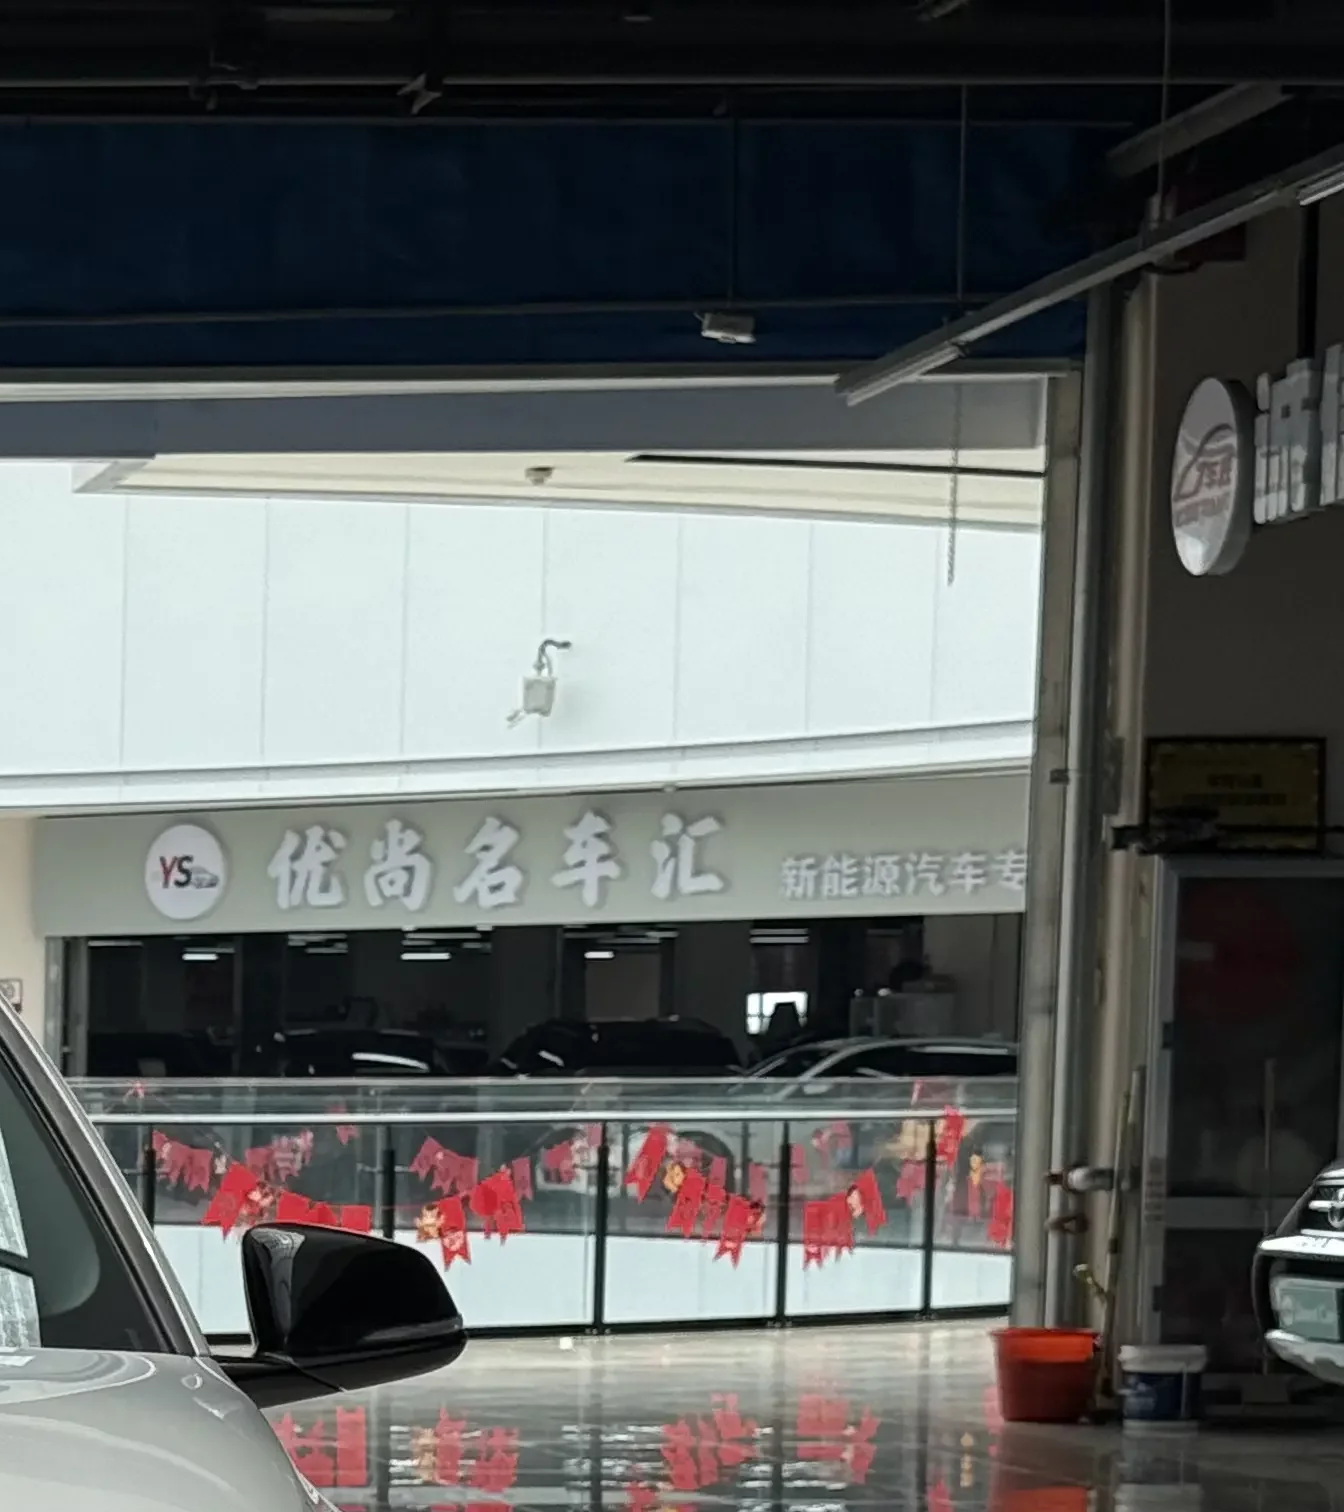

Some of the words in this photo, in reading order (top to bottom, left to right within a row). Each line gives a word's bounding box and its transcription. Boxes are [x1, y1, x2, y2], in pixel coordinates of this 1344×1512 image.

[159, 855, 194, 889] YS
[267, 812, 726, 912] 优尚名车汇
[780, 850, 1027, 898] 新能源汽车专
